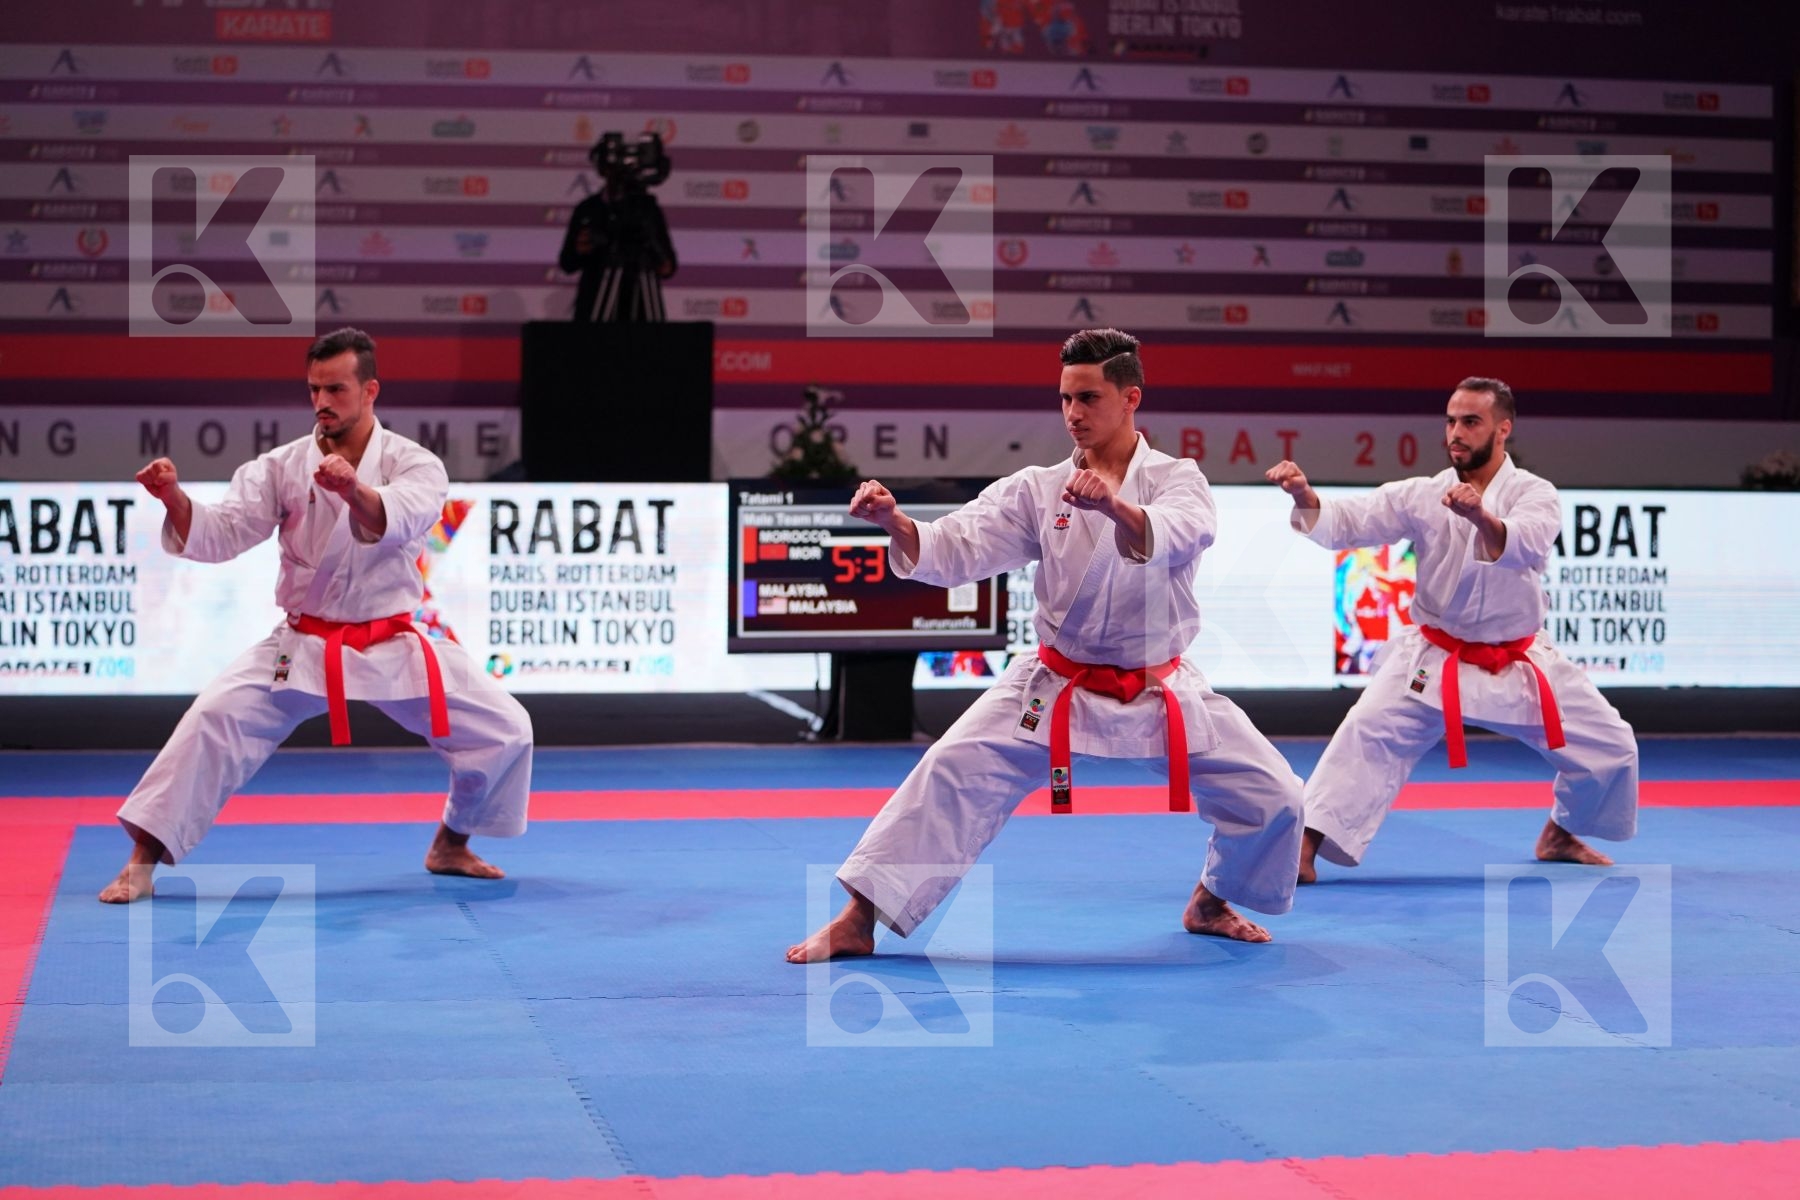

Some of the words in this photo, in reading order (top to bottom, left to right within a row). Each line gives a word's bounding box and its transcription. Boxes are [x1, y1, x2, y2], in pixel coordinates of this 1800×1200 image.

[223, 14, 322, 37] KARATE
[1108, 14, 1175, 36] BERLIN
[1181, 16, 1242, 38] TOKYO
[740, 491, 784, 505] Tatami
[786, 491, 794, 505] 1
[489, 499, 675, 554] RABAT
[743, 513, 774, 526] Male
[775, 512, 812, 526] Team
[812, 512, 844, 526] Kata
[759, 529, 831, 543] MOROCCO
[789, 546, 823, 560] MOR
[16, 564, 136, 584] ROTTERDAM
[489, 564, 548, 583] PARIS
[556, 564, 676, 583] ROTTERDAM
[1560, 567, 1668, 585] ROTTERDAM
[26, 590, 135, 613] ISTANBUL
[490, 590, 557, 612] DUBAI
[567, 590, 675, 612] ISTANBUL
[759, 584, 828, 598] MALAYSIA
[1569, 590, 1667, 612] ISTANBUL
[788, 600, 858, 614] MALAYSIA
[51, 620, 135, 646] TOKYO
[489, 619, 578, 645] BERLIN
[592, 619, 675, 645] TOKYO
[1591, 618, 1665, 643] TOKYO
